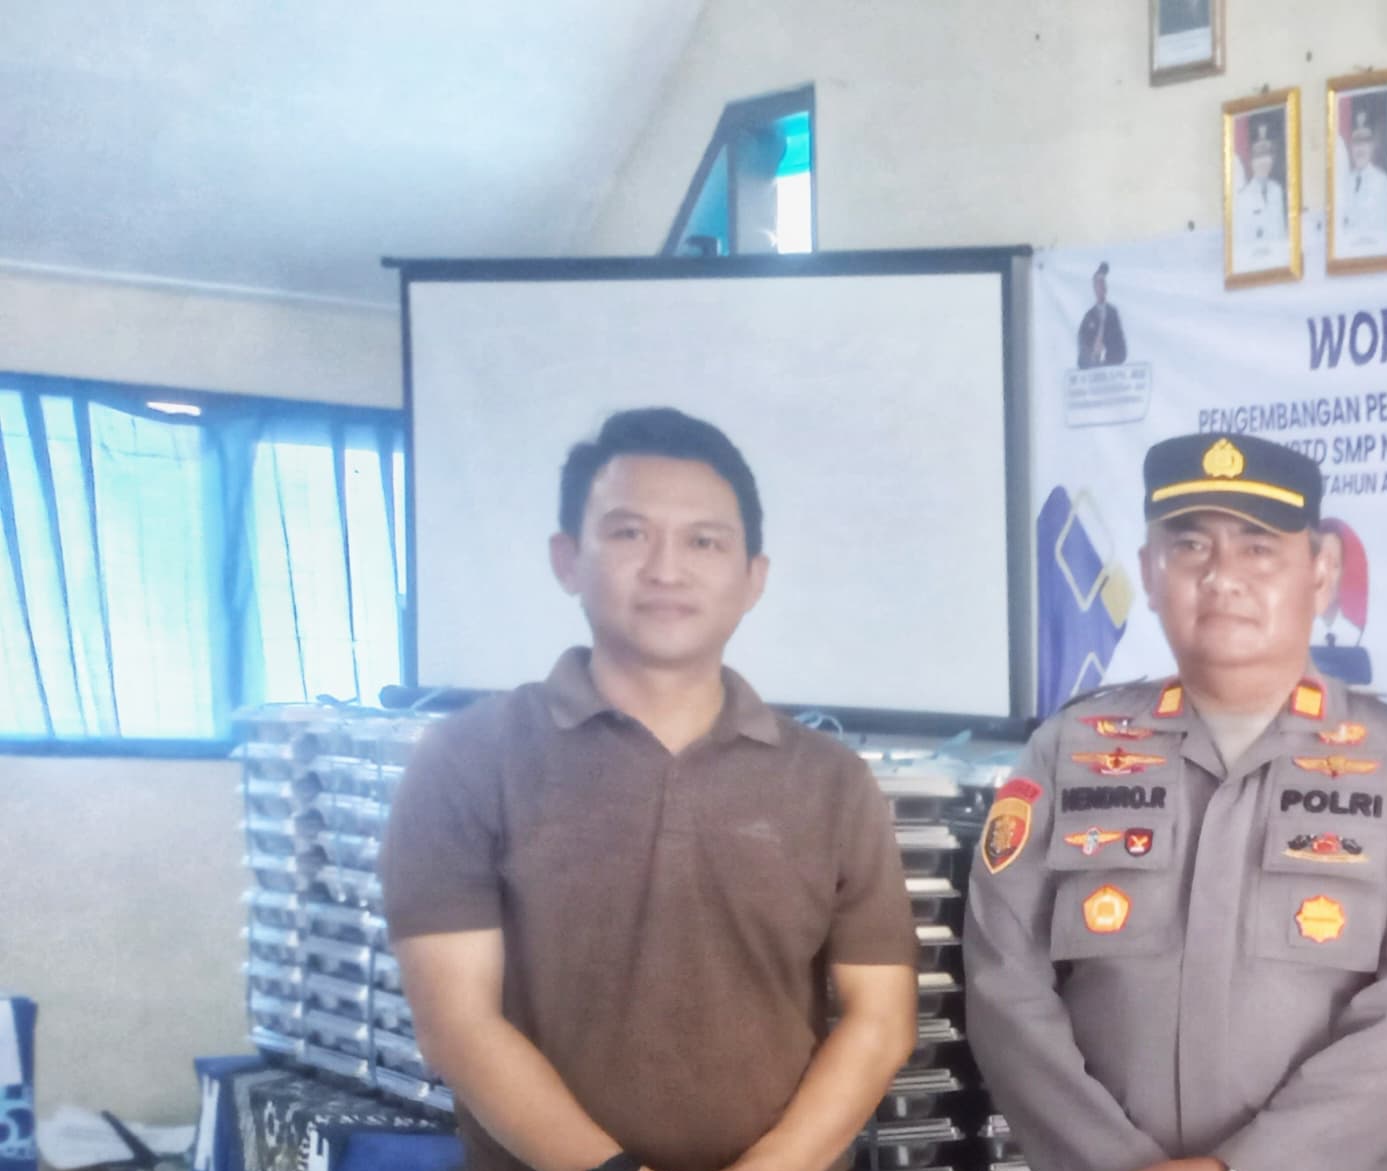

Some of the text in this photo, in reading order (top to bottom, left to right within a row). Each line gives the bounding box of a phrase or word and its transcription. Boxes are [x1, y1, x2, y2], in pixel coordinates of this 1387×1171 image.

[1199, 396, 1361, 434] PENGEMBANGAN
[1332, 436, 1376, 465] SMP
[1321, 472, 1377, 496] TAHUN
[1280, 789, 1383, 819] POLRI
